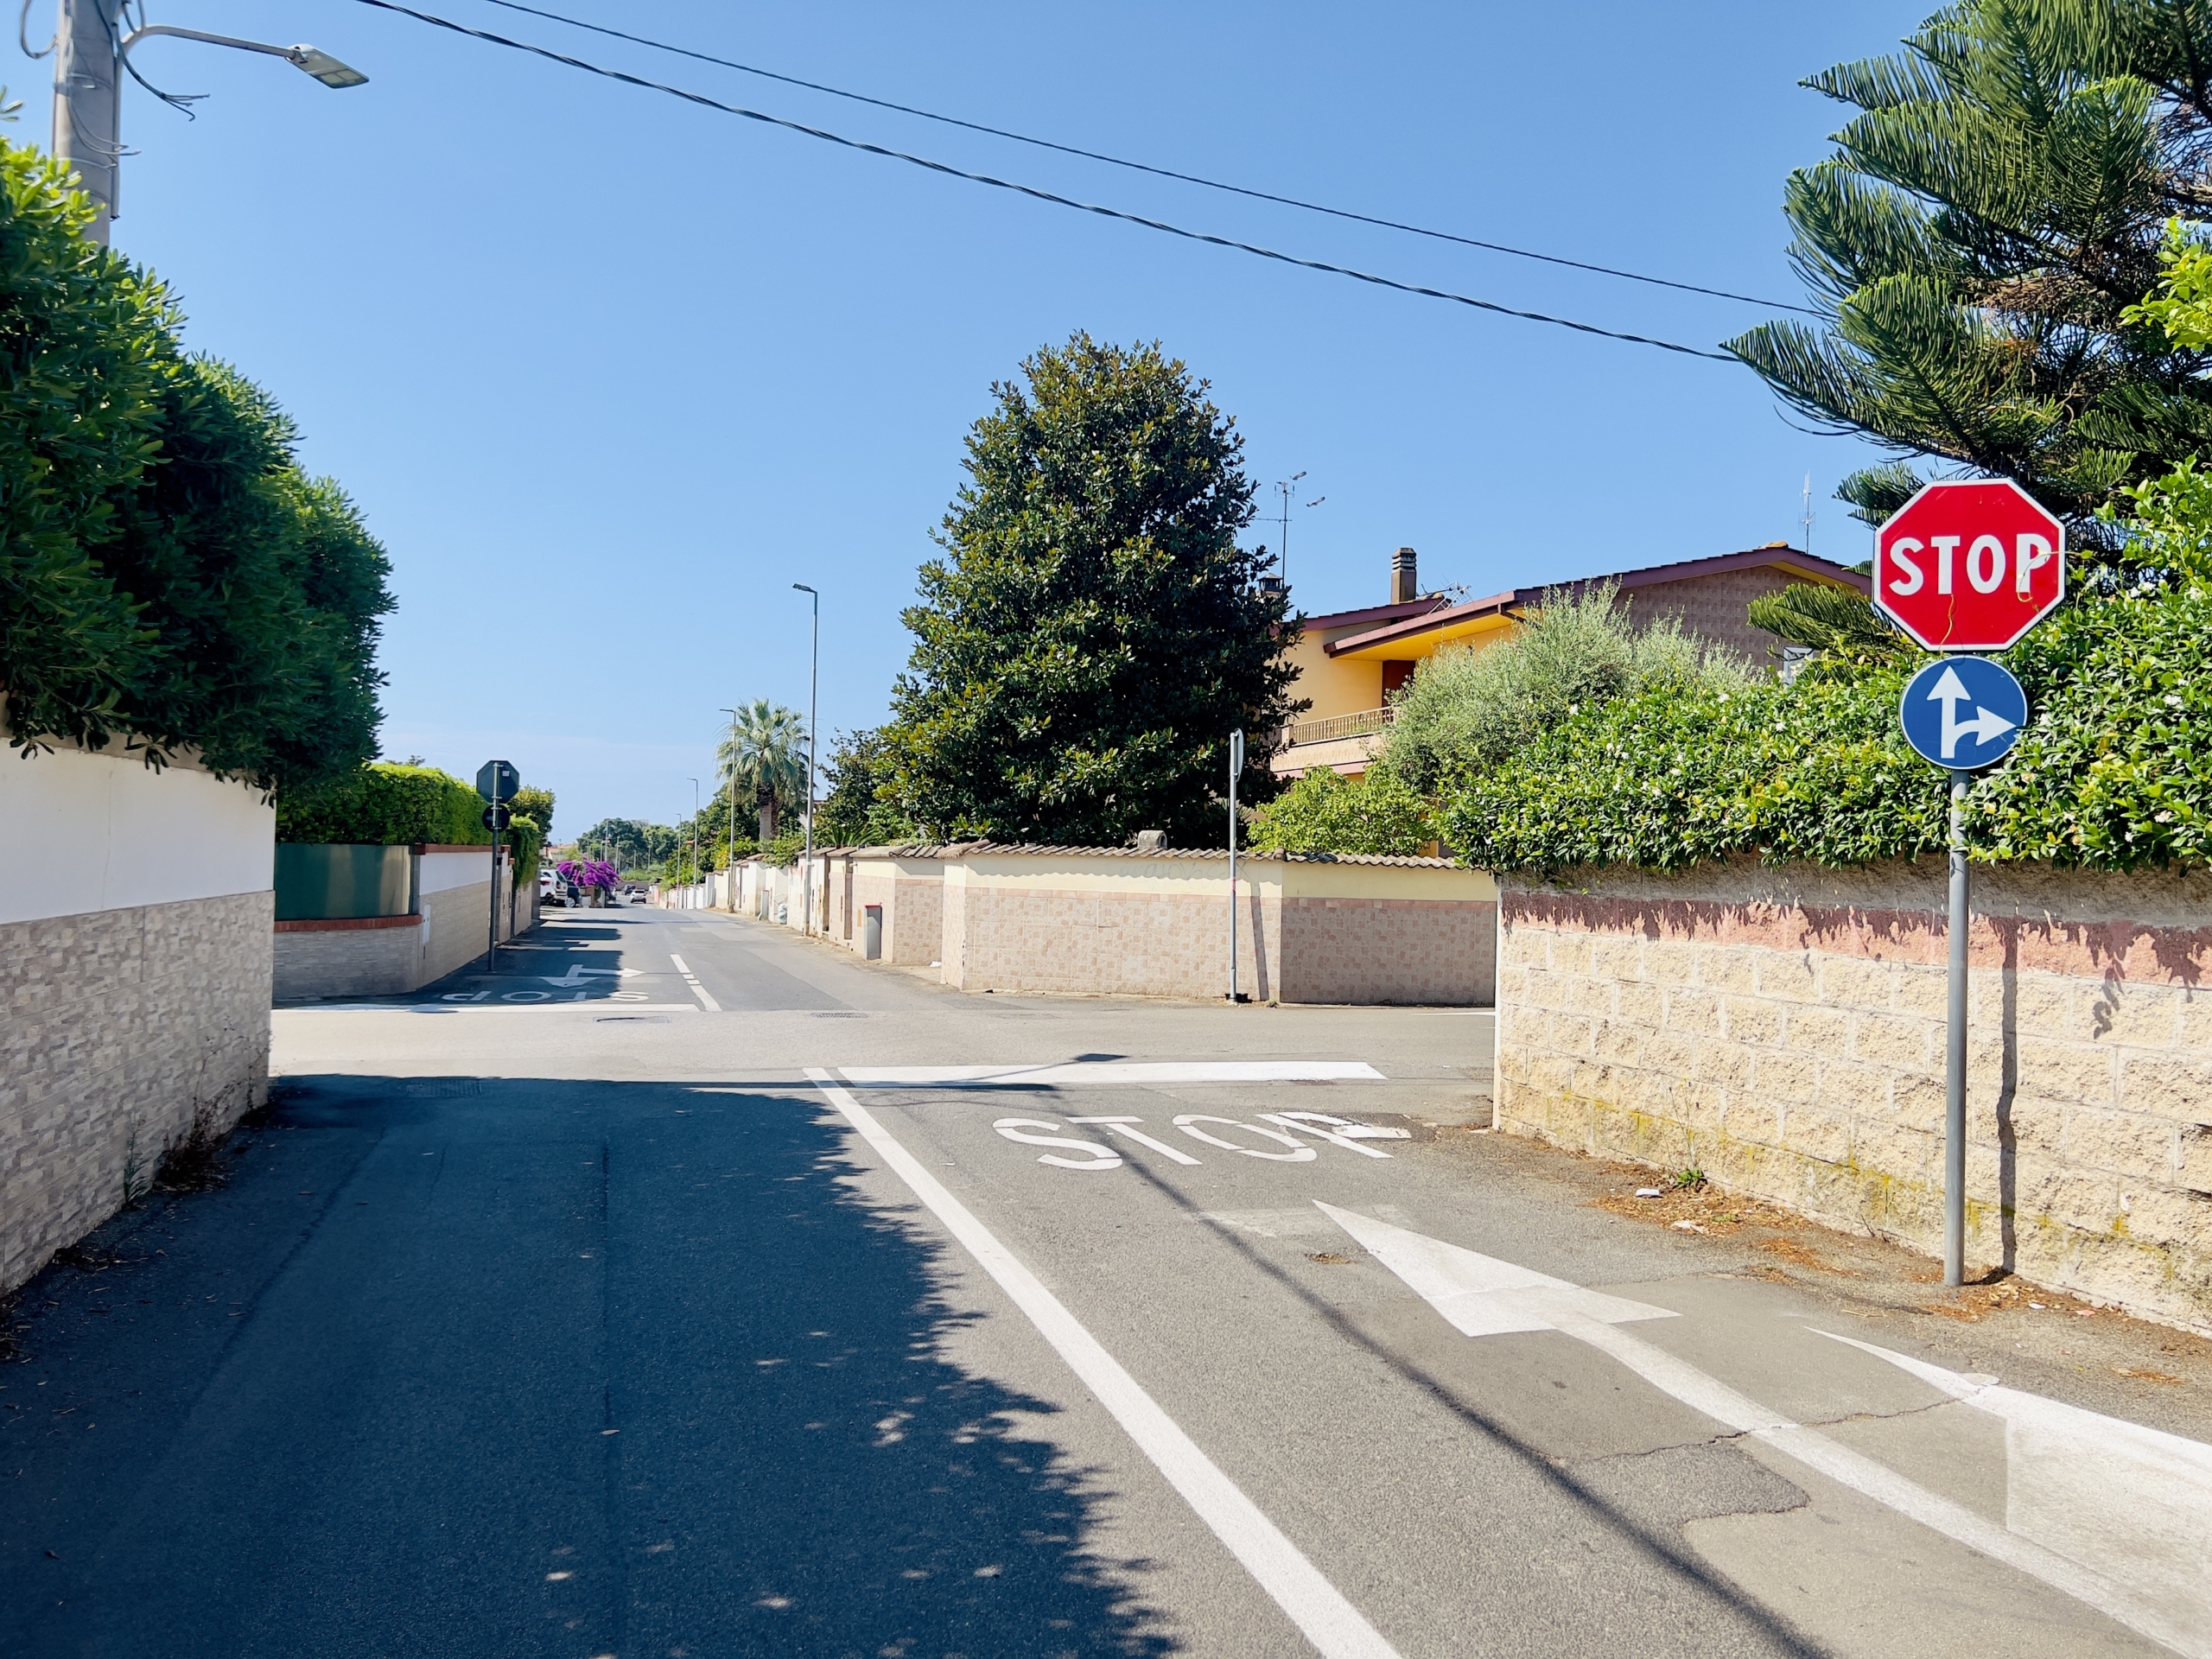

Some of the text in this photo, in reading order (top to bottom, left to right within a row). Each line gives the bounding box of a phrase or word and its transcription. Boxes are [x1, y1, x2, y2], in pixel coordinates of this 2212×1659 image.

[1888, 533, 2052, 596] STOP
[442, 990, 649, 1002] STOP
[993, 1111, 1413, 1170] STOP
